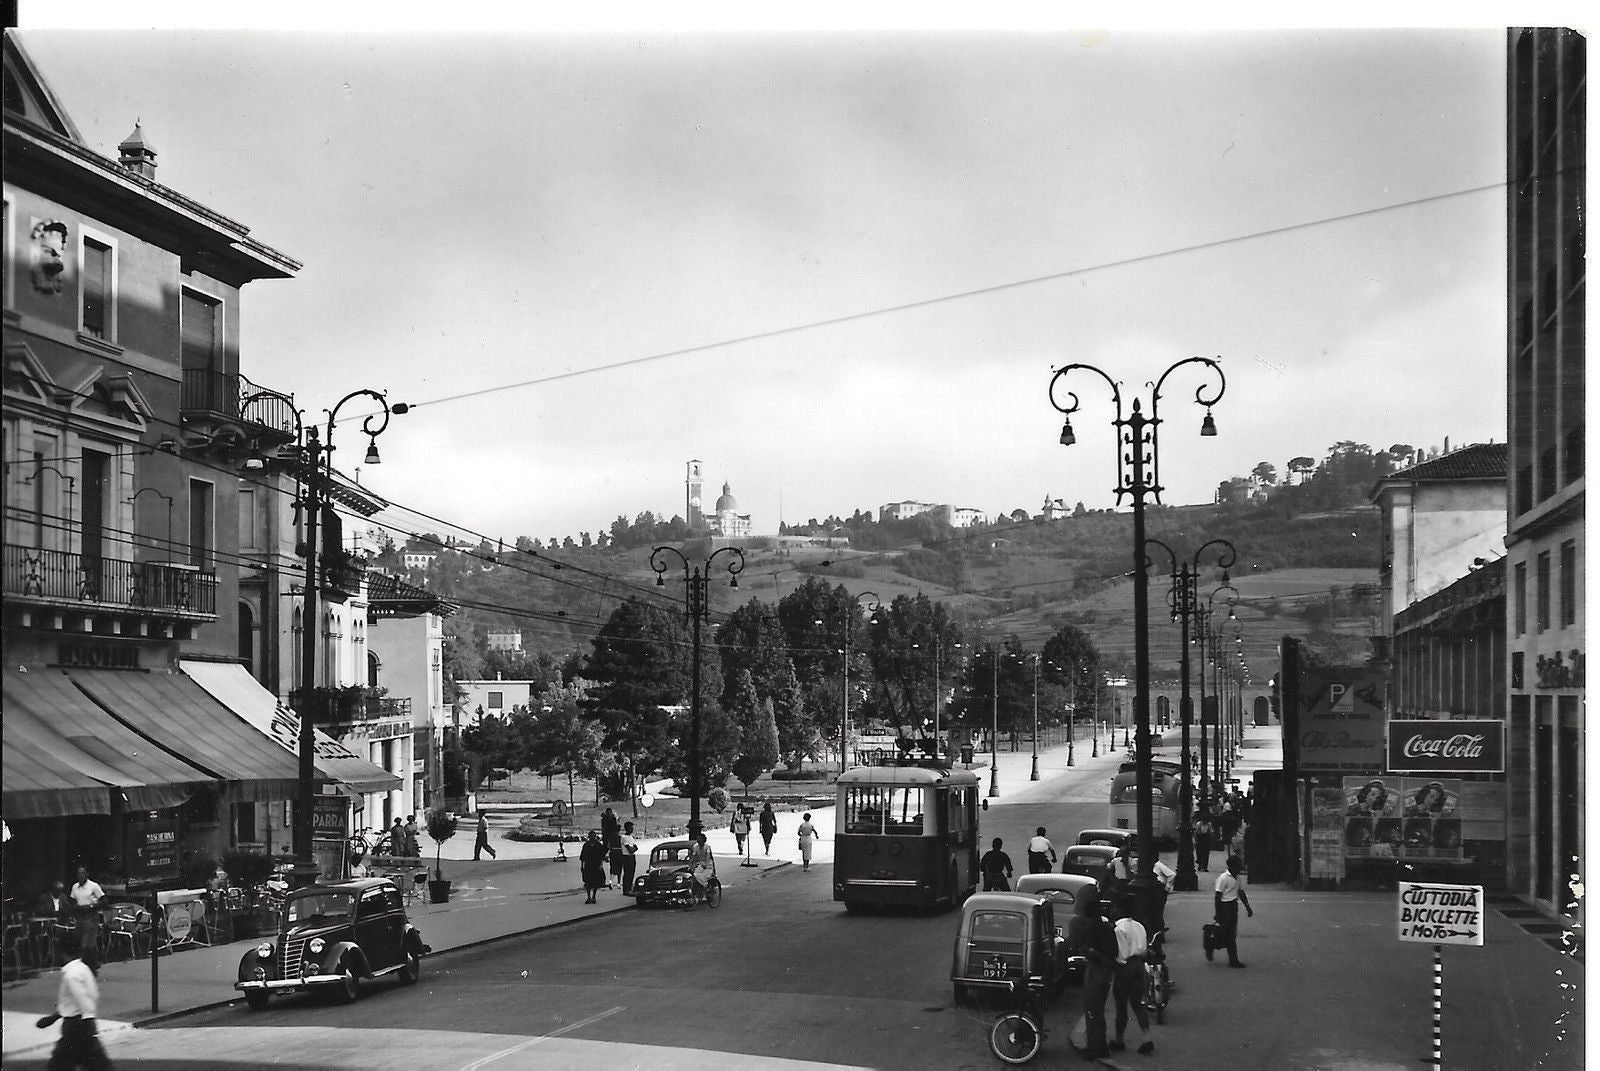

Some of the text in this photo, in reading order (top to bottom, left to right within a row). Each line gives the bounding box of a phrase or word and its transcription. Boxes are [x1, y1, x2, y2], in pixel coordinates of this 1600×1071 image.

[1330, 684, 1345, 703] P
[1403, 733, 1486, 758] Coca-Cola
[1402, 891, 1477, 907] CUSTODIA
[1401, 908, 1479, 925] BICICLETTE
[984, 970, 1007, 978] 0917
